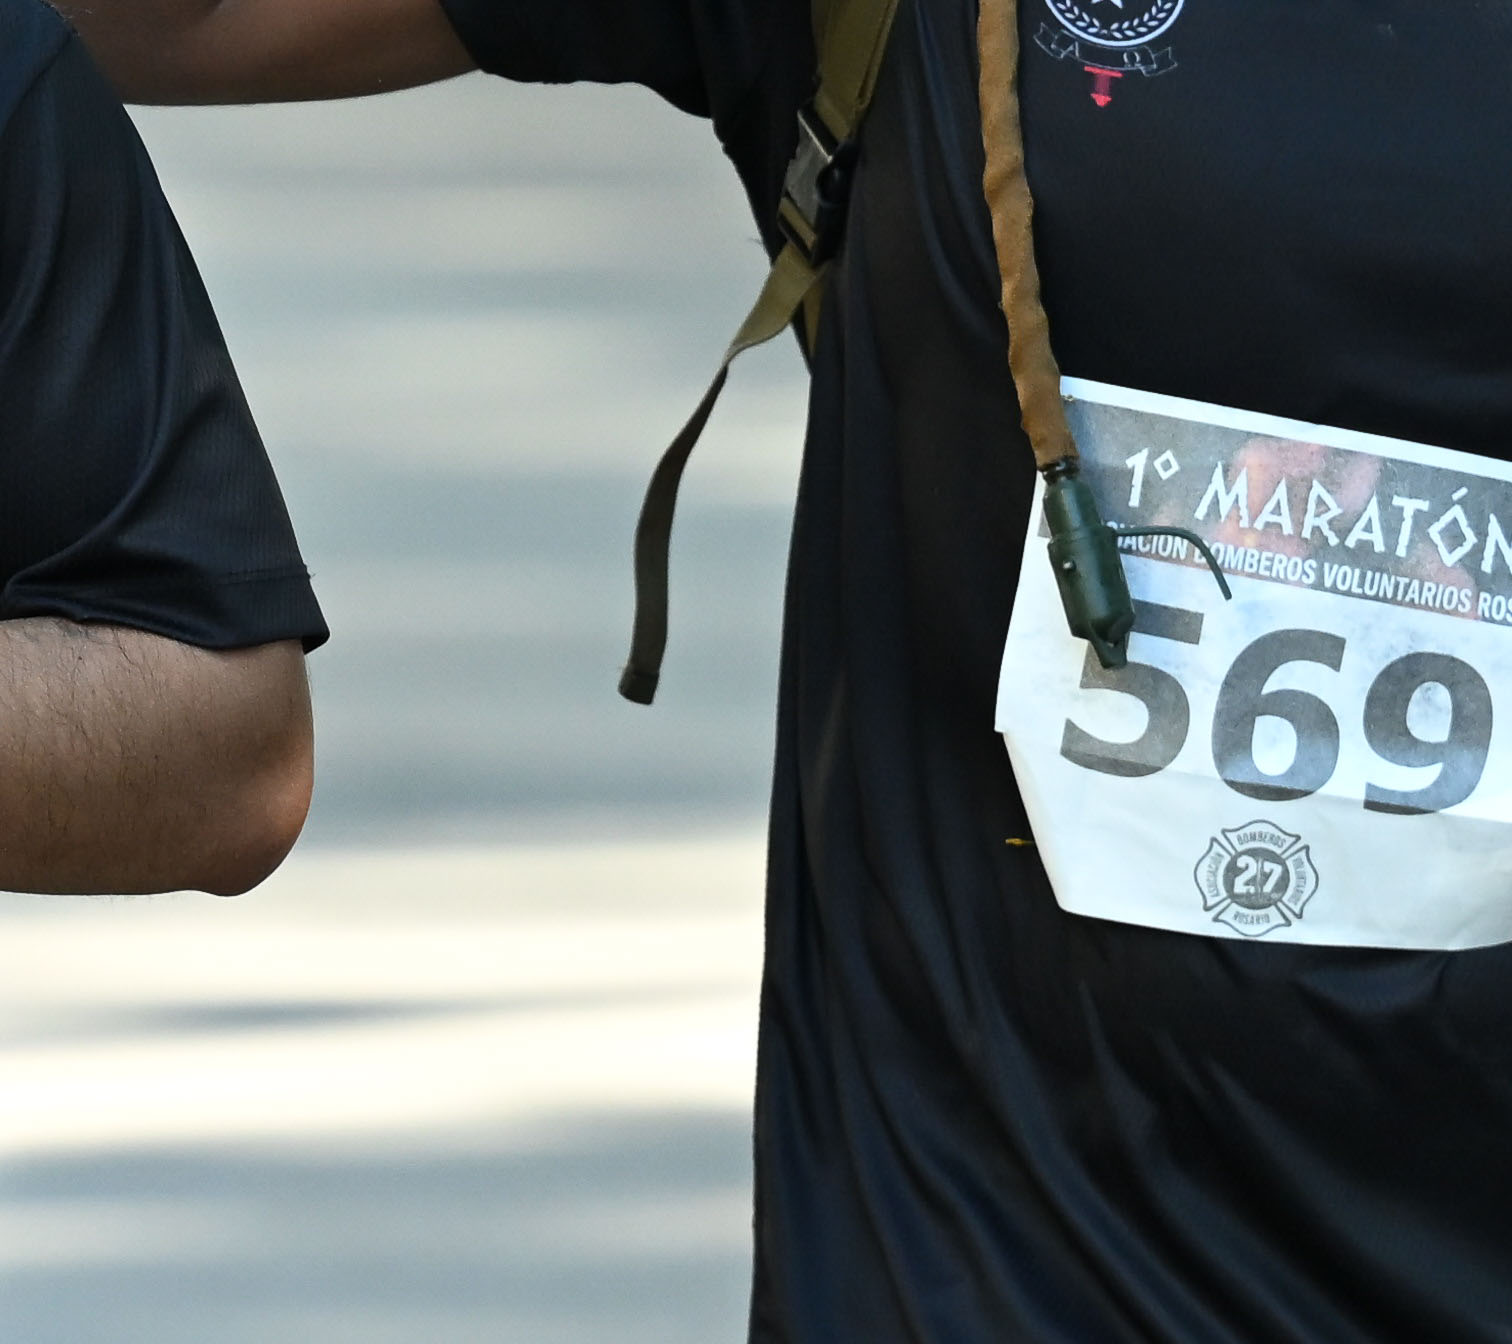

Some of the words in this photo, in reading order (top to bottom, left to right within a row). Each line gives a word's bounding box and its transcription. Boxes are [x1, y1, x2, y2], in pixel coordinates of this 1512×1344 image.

[1323, 561, 1473, 613] VOLUNTARIOS
[1059, 593, 1494, 816] 569
[1233, 854, 1283, 894] 27
